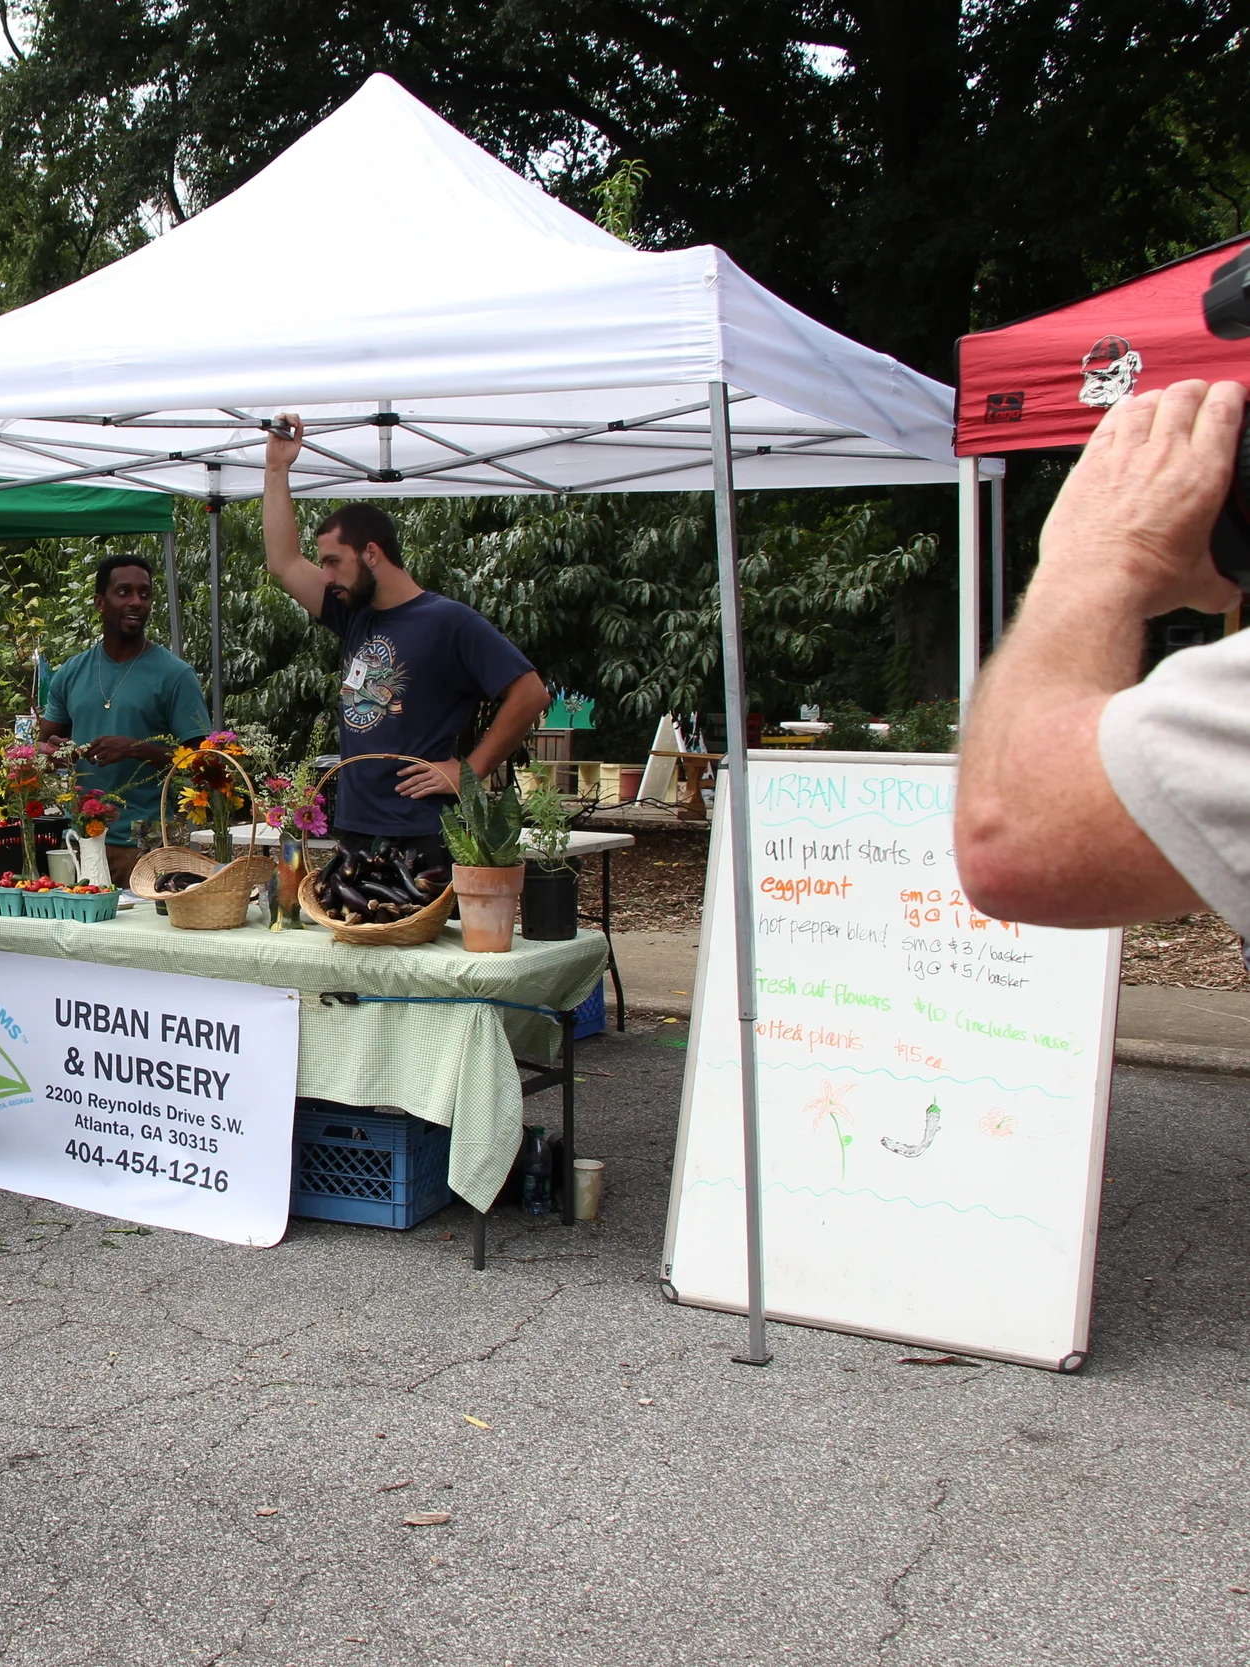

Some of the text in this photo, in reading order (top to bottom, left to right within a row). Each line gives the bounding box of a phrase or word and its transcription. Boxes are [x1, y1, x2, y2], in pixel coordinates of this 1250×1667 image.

[344, 707, 375, 724] BEER
[755, 774, 957, 813] URBAN SPROU
[764, 836, 792, 862] all
[802, 839, 853, 869] plant
[858, 838, 911, 867] starts
[760, 875, 853, 905] eggplant
[758, 912, 888, 948] hot pepper blend
[967, 913, 992, 931] for
[801, 978, 830, 998] cut
[834, 981, 892, 1012] flowers
[914, 997, 947, 1023] $10
[54, 997, 241, 1055] URBAN FARM
[808, 1024, 864, 1053] plants
[63, 1046, 230, 1101] & NURSERY
[8, 1097, 35, 1109] GEORGIA
[45, 1084, 245, 1136] 2200 Reynolds Drive S.W.
[74, 1113, 219, 1154] Atlanta, GA 30315
[65, 1139, 229, 1194] 404-454-1216
